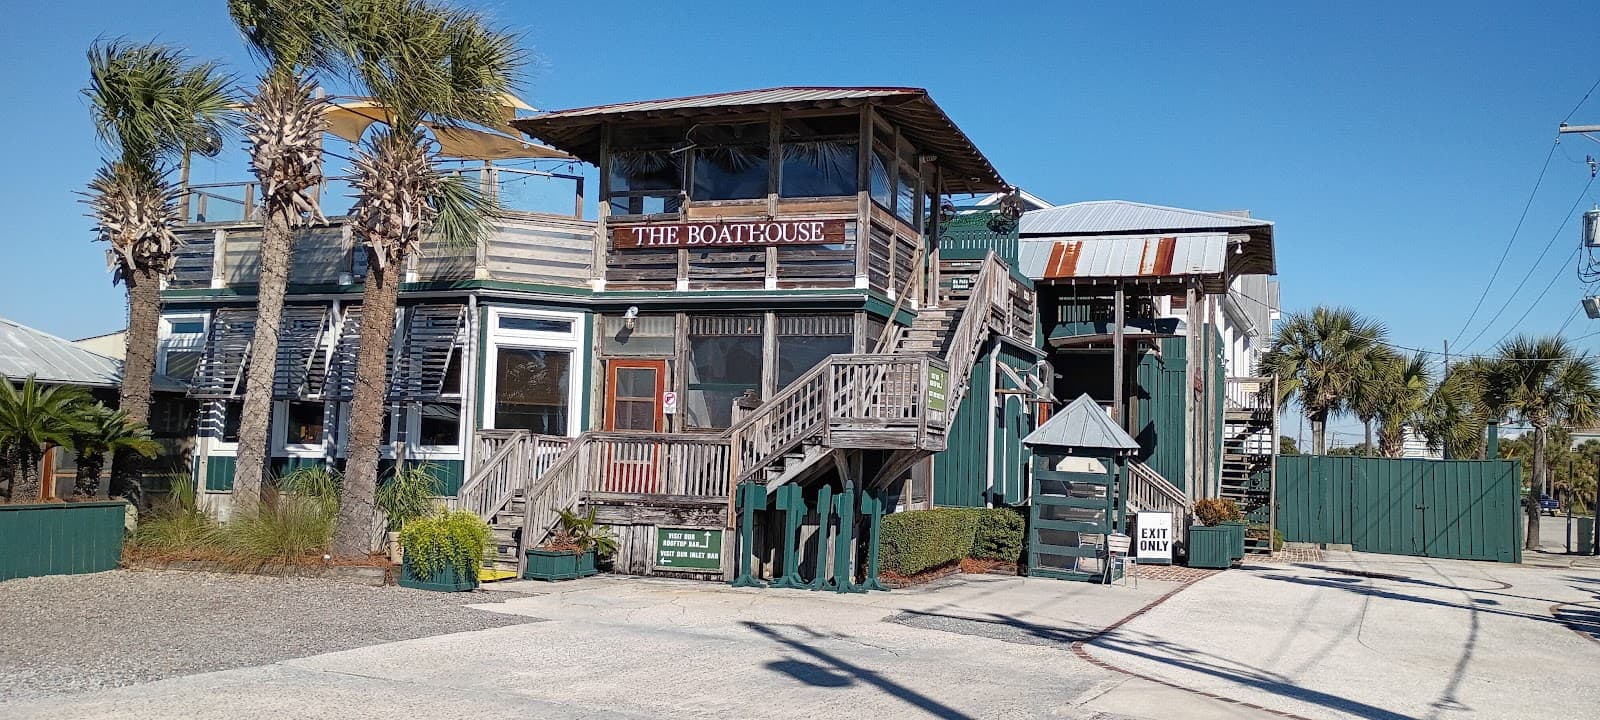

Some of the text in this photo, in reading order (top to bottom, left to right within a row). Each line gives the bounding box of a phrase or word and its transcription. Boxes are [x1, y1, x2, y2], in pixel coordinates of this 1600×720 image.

[632, 221, 824, 246] THE BOATHOUSE
[1141, 528, 1168, 539] EXIT
[1140, 540, 1169, 552] ONLY
